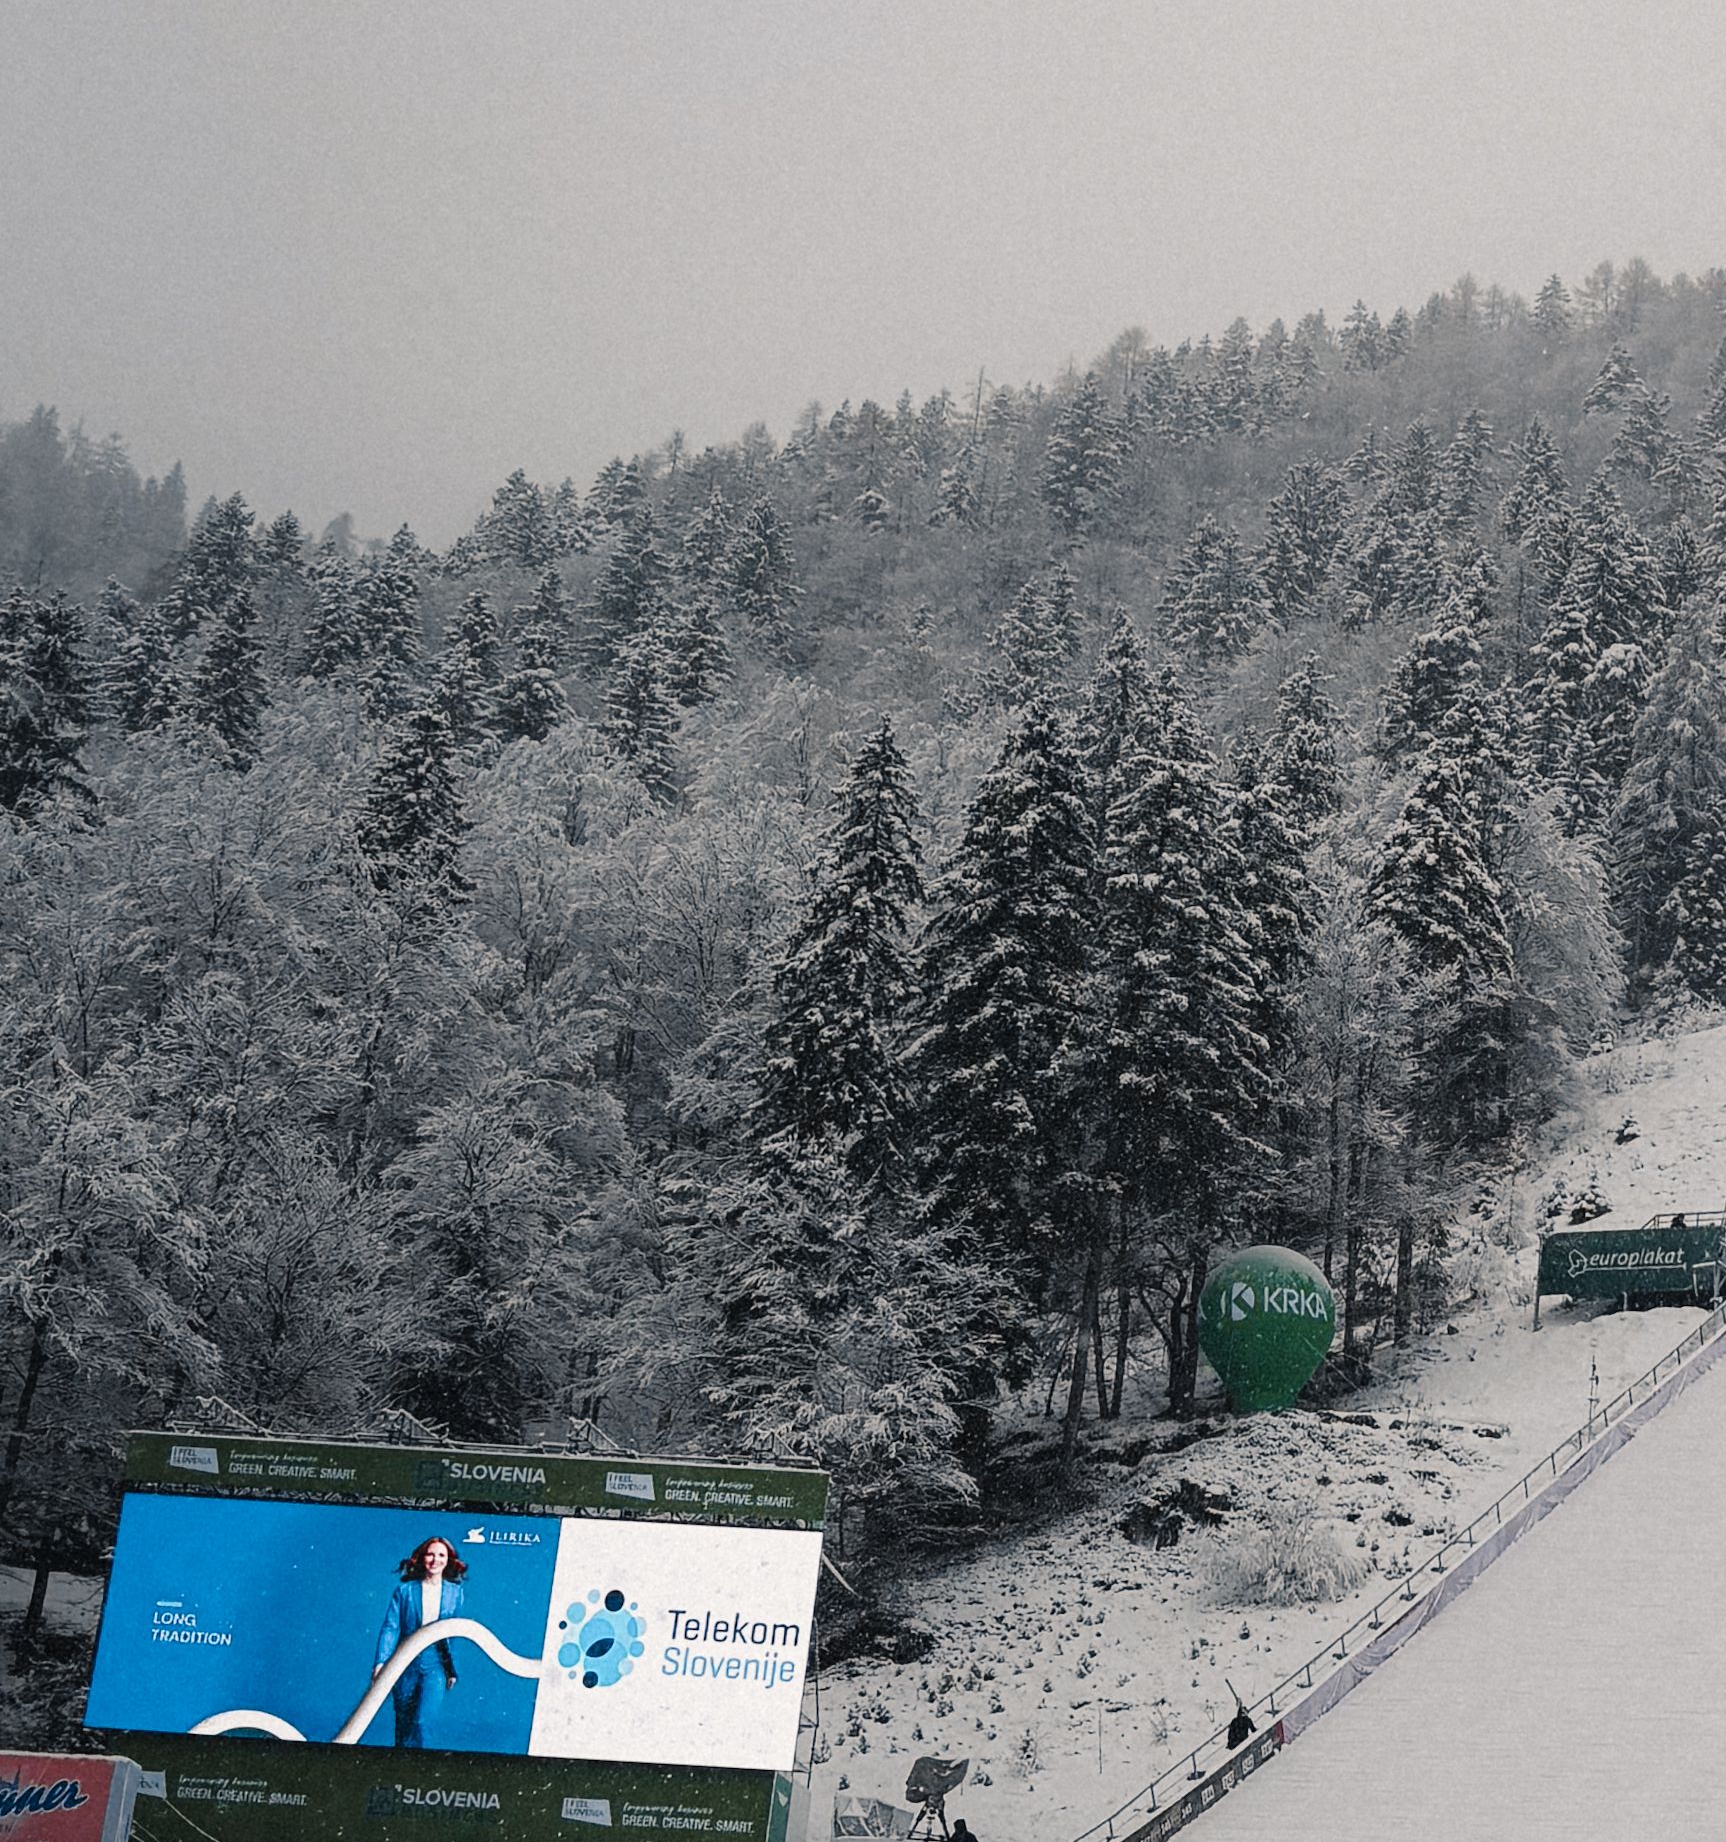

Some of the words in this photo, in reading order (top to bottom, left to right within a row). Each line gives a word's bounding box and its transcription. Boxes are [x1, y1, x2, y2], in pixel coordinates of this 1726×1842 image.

[1589, 1247, 1685, 1269] europlakat
[1263, 1286, 1328, 1322] KRKA
[450, 1463, 546, 1484] SLOVENIA
[490, 1531, 541, 1543] ILIRIKA
[153, 1612, 197, 1627] LONG
[668, 1609, 800, 1647] Telekom
[151, 1628, 232, 1646] TRADITION
[661, 1646, 795, 1689] Slovenije
[402, 1788, 500, 1809] SLOVENIA
